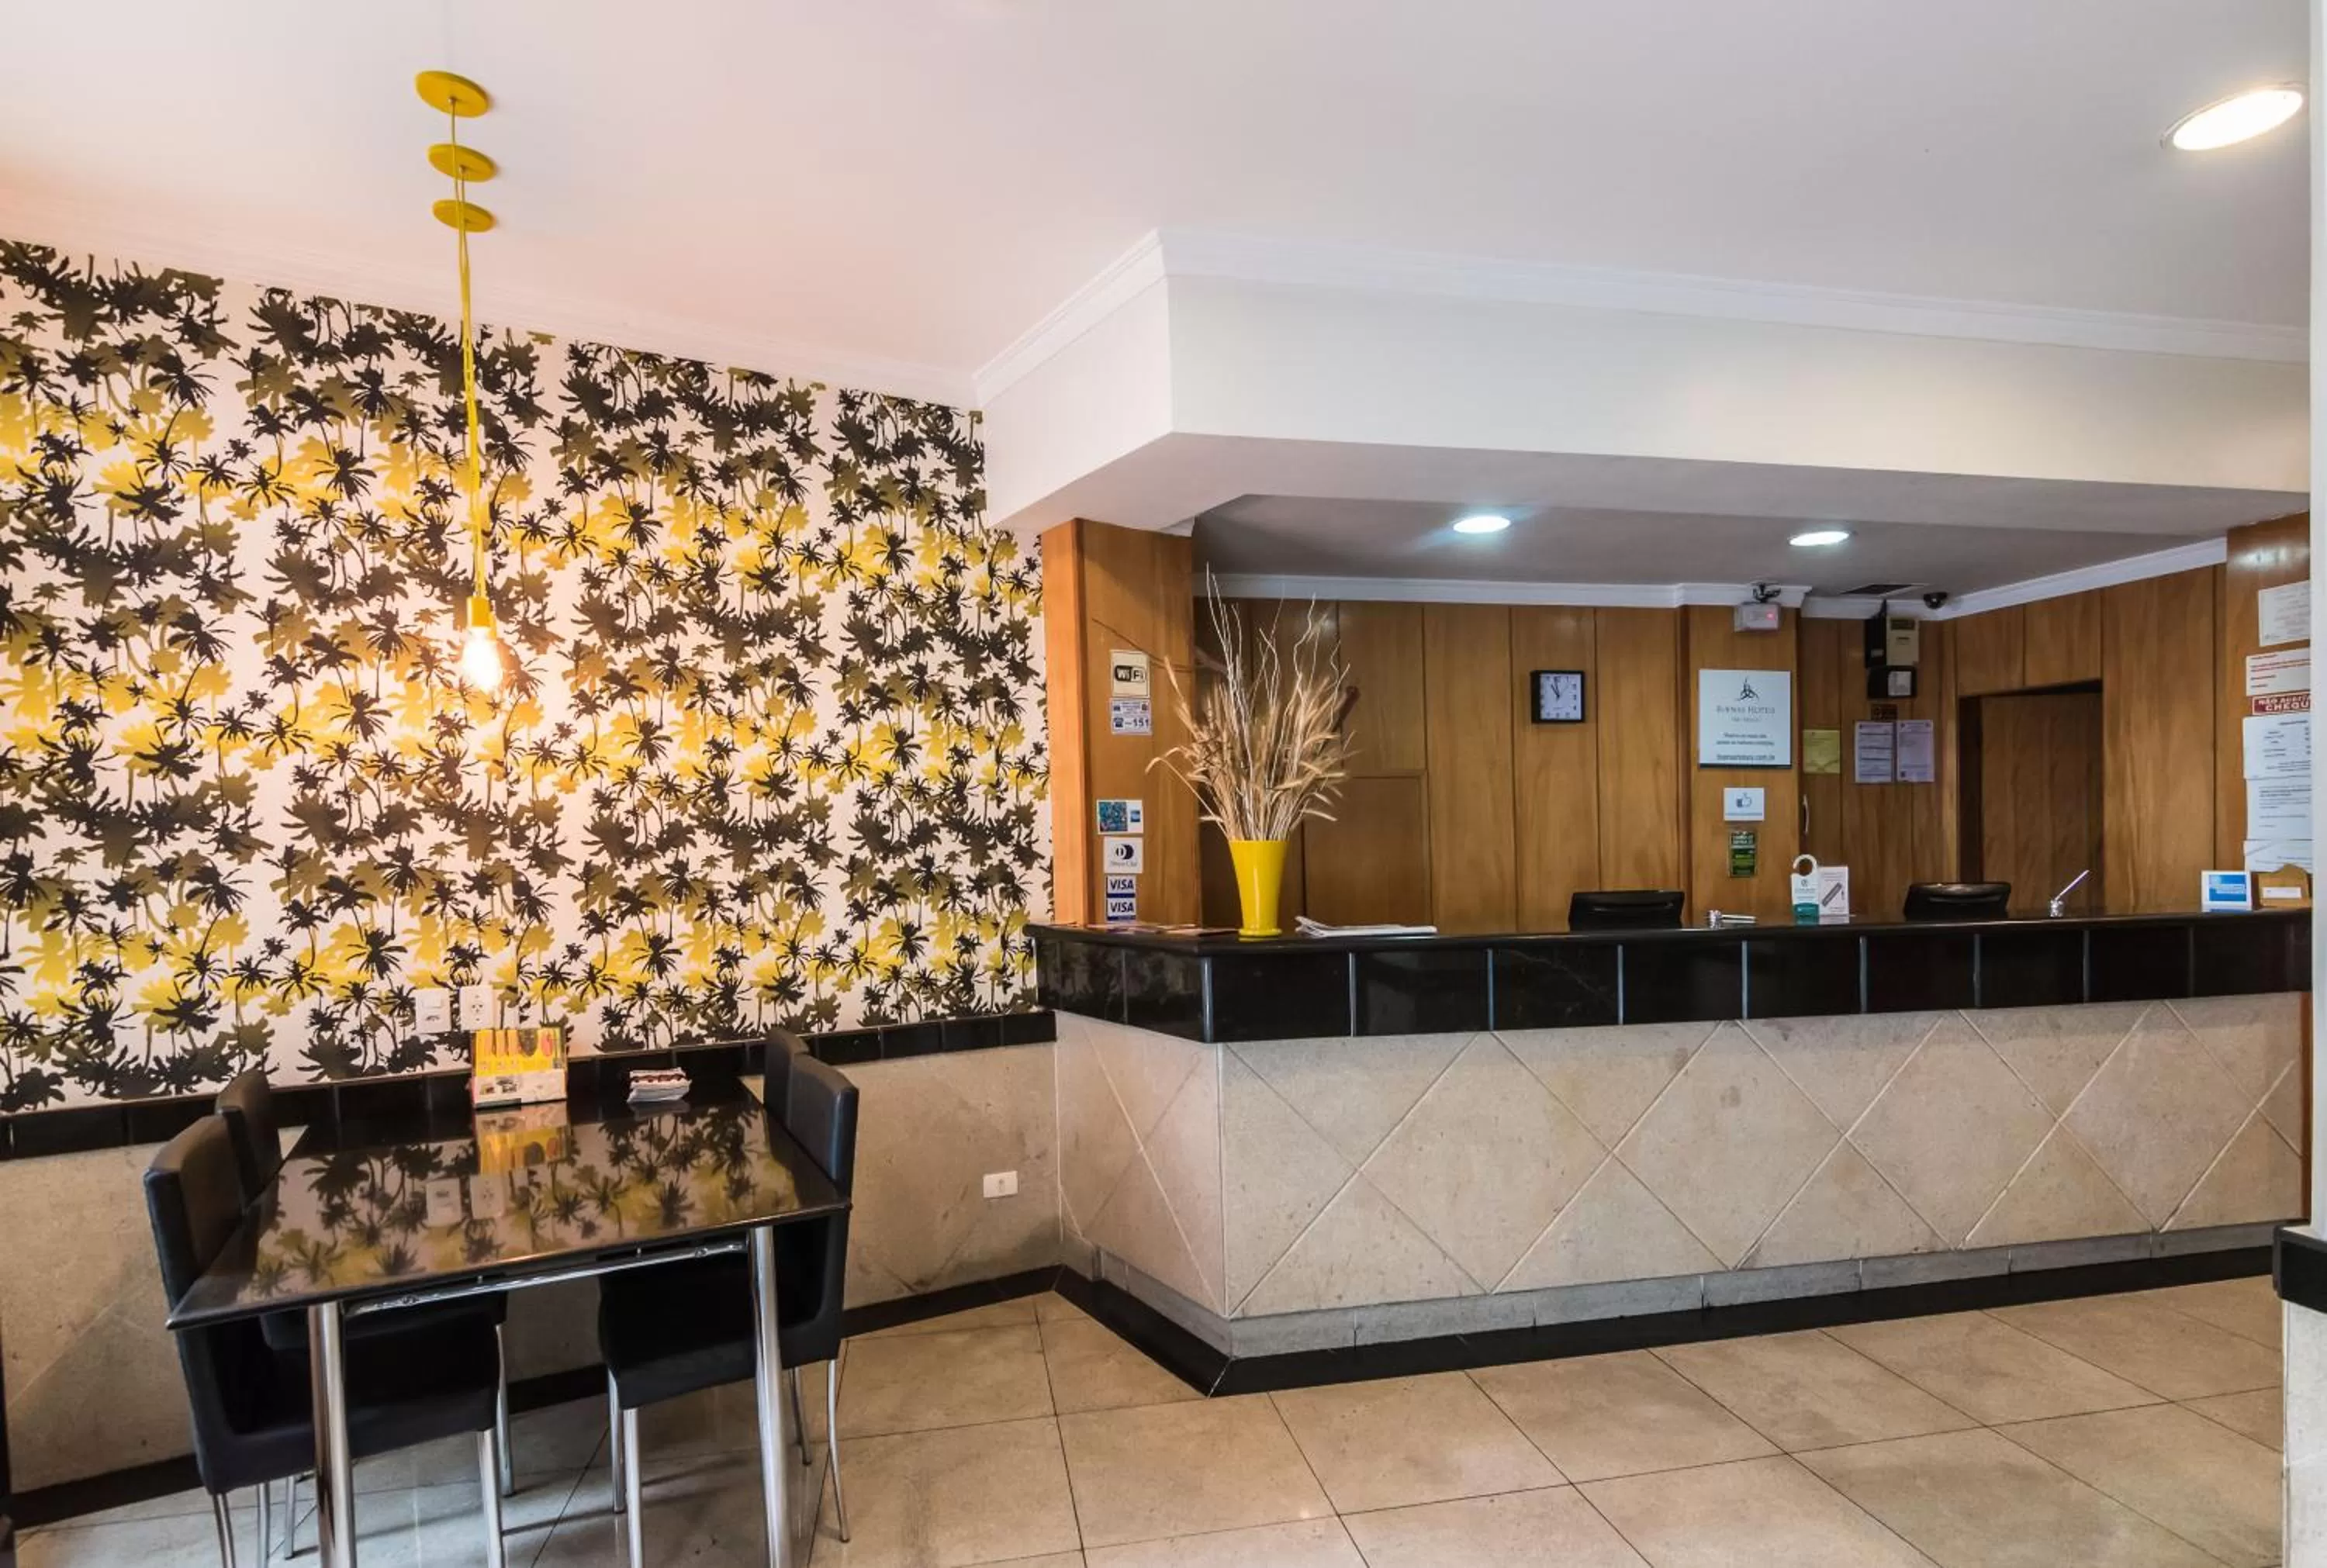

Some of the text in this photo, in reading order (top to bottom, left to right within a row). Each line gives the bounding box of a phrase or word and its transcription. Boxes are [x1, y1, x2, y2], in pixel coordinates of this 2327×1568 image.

[2265, 700, 2309, 711] CHEQU
[1109, 879, 1134, 889] VISA
[1110, 902, 1134, 913] VISA
